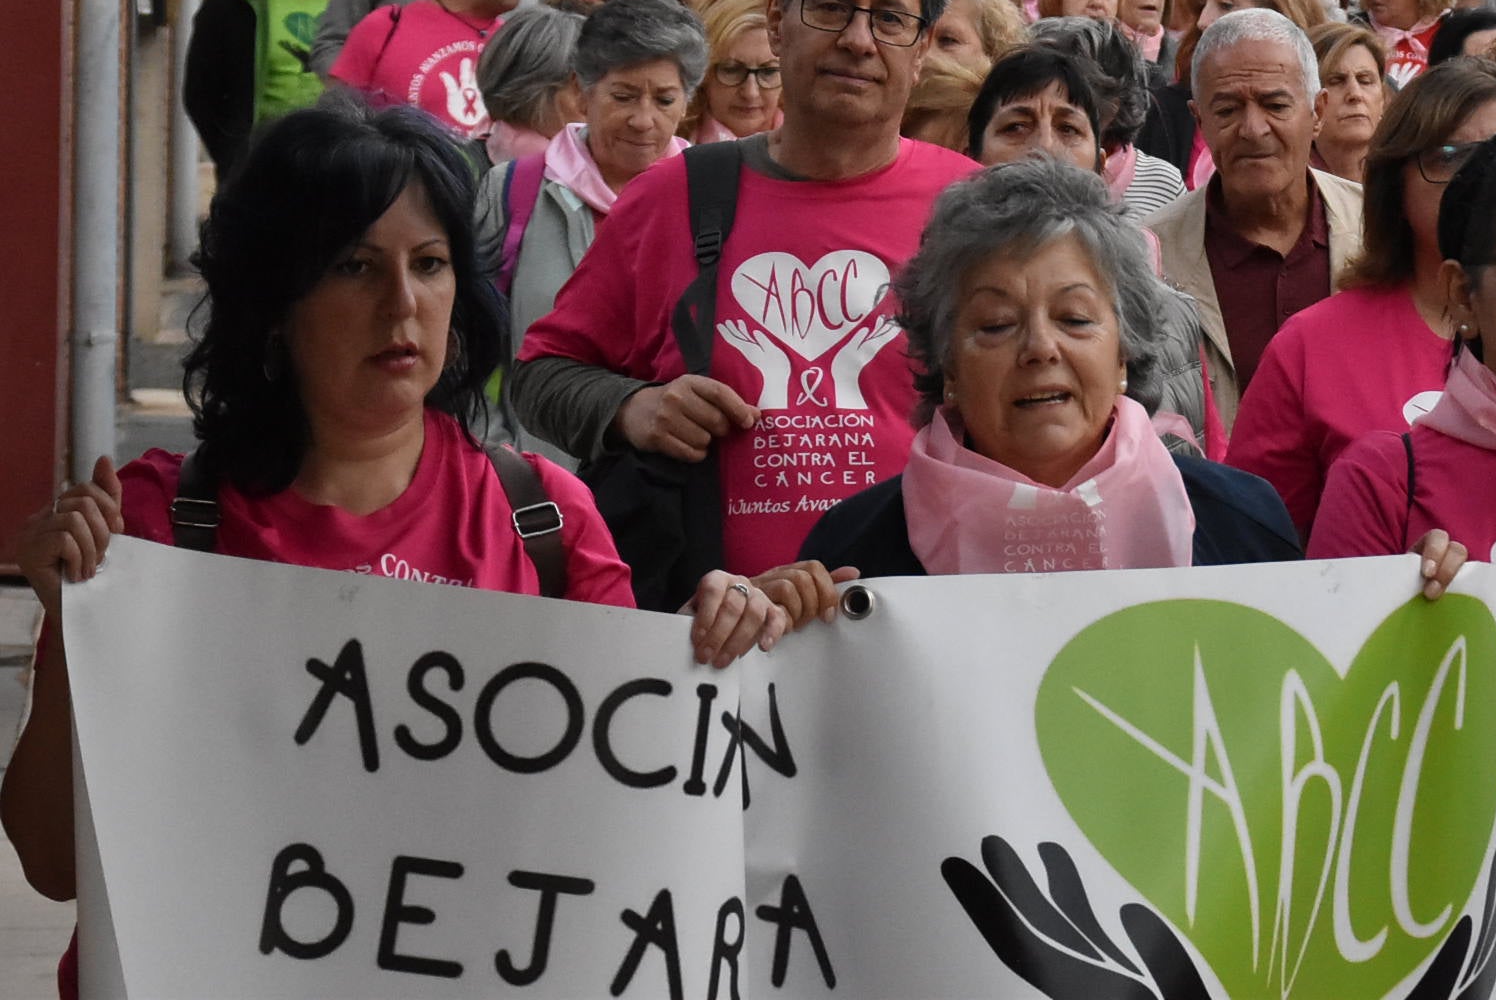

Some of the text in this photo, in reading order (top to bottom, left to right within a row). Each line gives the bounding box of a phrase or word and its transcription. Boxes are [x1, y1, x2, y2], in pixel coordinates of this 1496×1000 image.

[739, 258, 864, 341] ABCC
[754, 412, 875, 432] ASOCIACIÓN
[753, 432, 875, 450] BEJARANA
[753, 451, 875, 468] CONTRA EL
[1004, 542, 1077, 556] CONTRA
[1071, 636, 1467, 1000] ABCC
